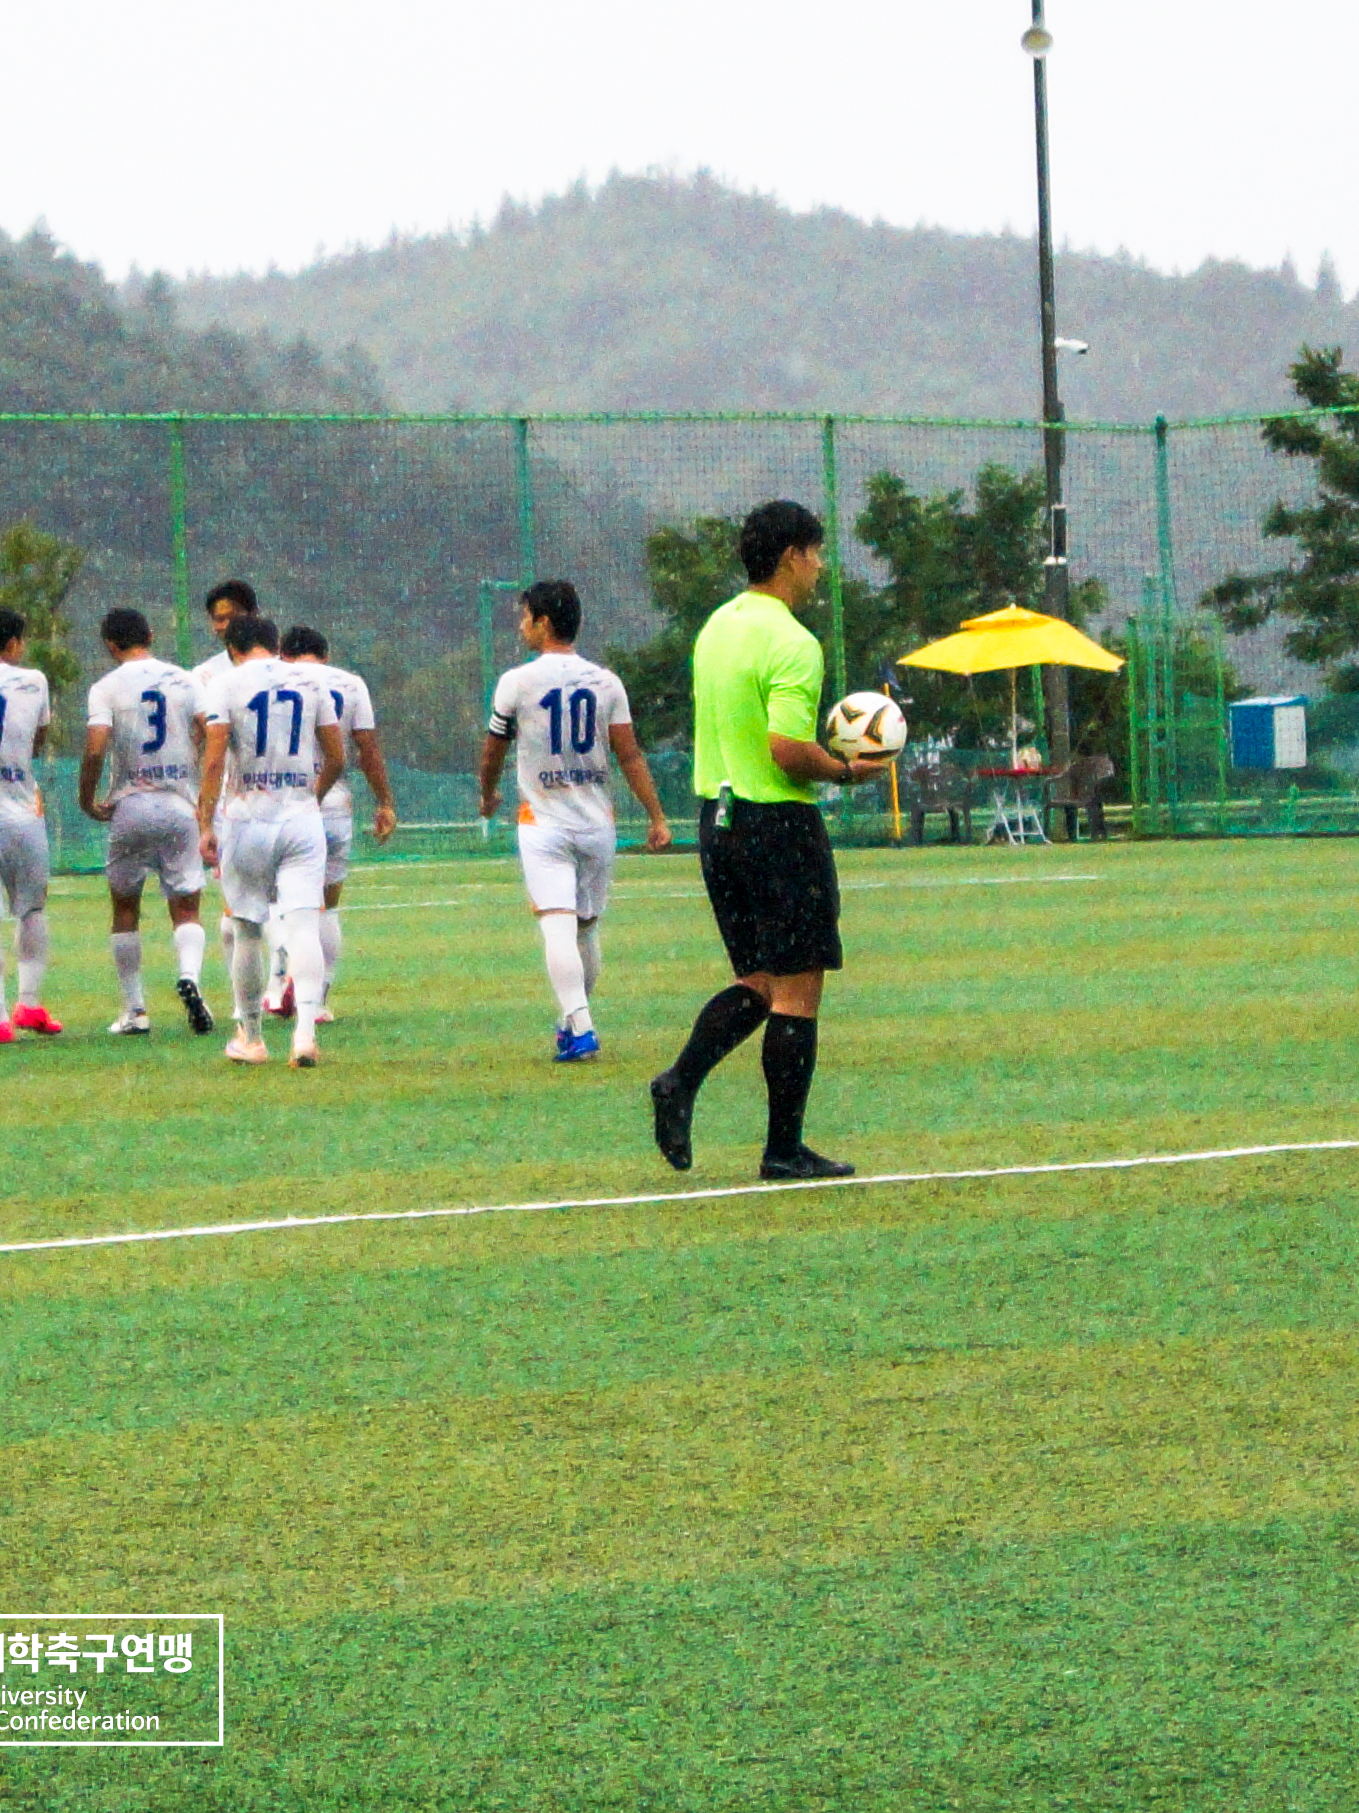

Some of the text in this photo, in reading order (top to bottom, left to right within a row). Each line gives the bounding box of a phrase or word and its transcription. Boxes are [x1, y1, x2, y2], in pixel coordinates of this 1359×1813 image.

[141, 690, 167, 755] 3
[247, 689, 304, 757] 17
[539, 687, 597, 755] 10
